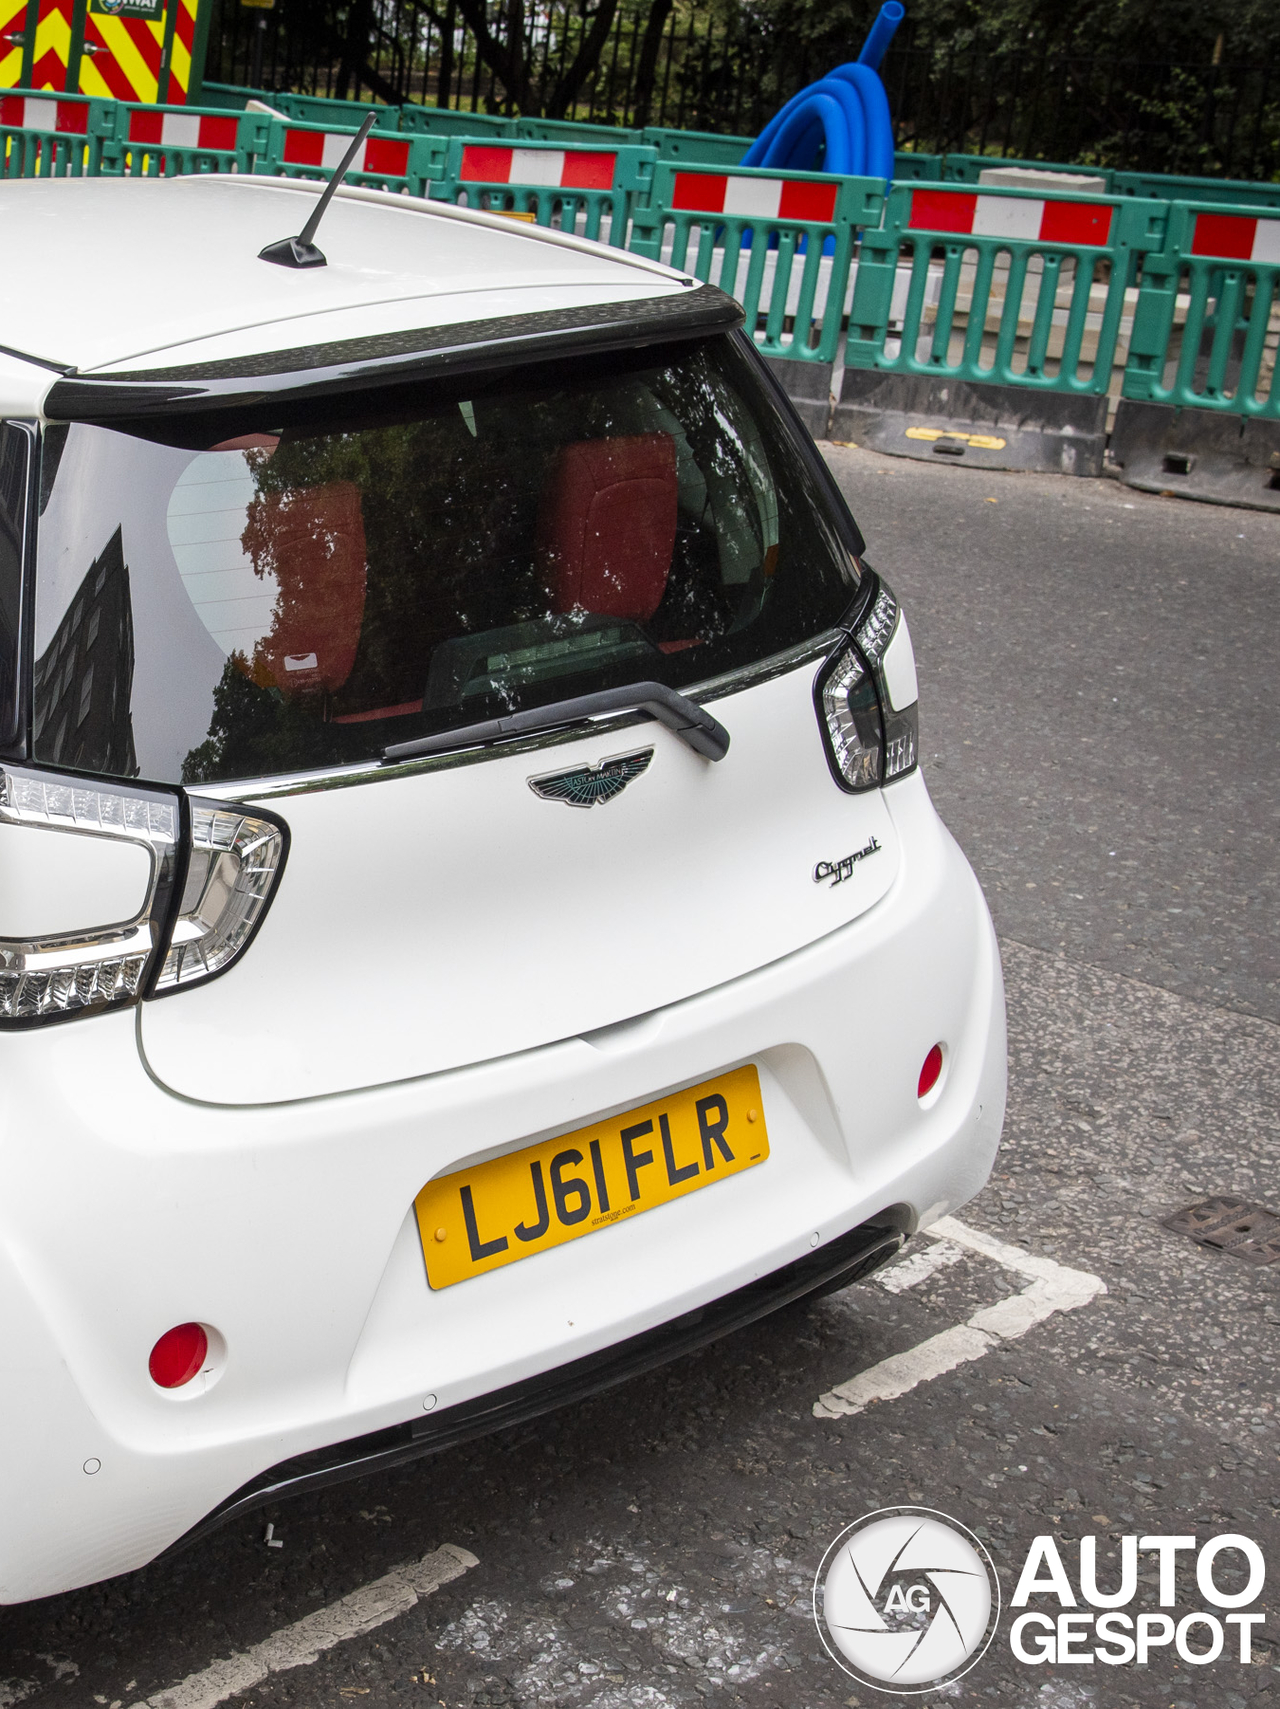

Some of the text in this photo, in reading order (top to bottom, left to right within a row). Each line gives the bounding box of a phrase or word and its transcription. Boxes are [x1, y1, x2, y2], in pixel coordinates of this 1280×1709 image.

[573, 767, 621, 786] ASTON MARTIN
[812, 836, 882, 888] Cygnet
[460, 1093, 736, 1262] LJ61 FLR
[592, 1204, 636, 1226] stratstone.com
